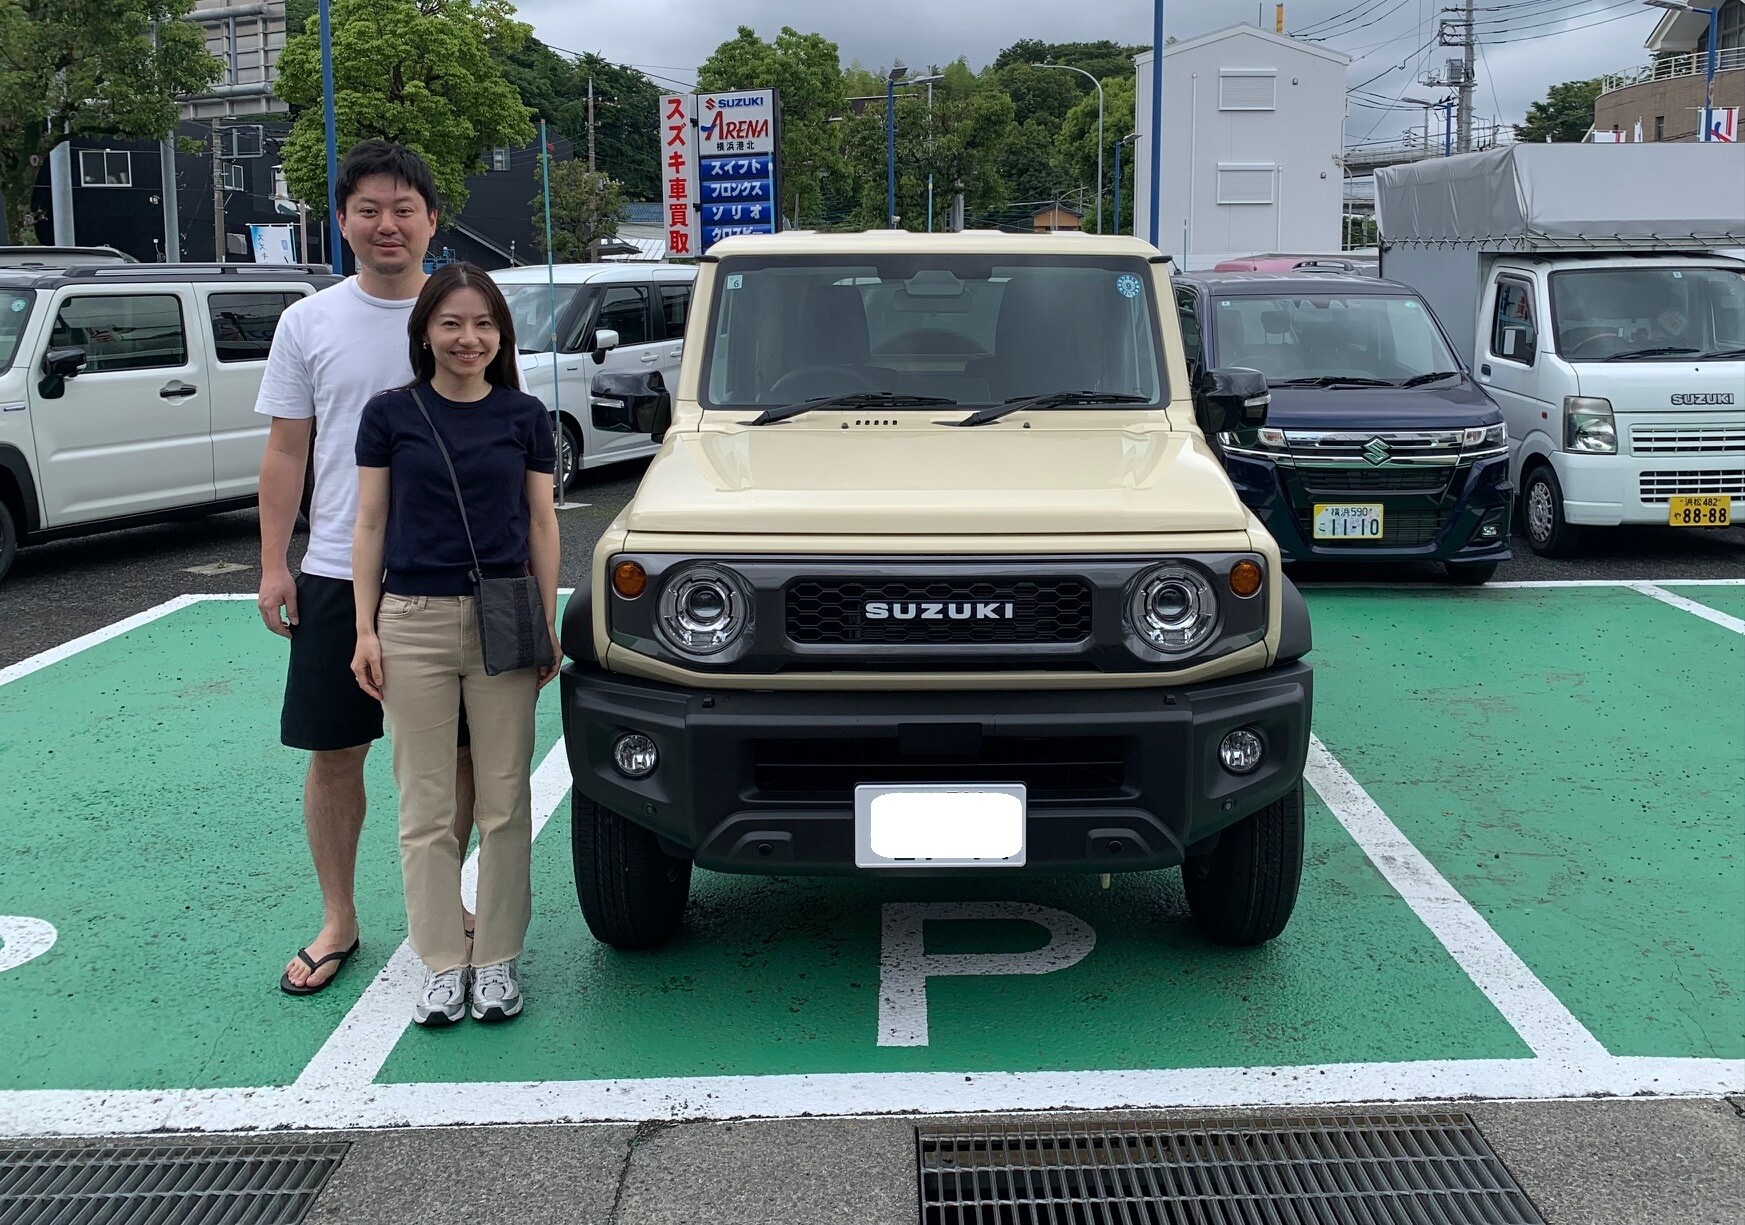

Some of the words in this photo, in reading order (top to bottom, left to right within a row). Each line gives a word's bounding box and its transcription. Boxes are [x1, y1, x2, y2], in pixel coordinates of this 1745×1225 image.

[718, 96, 764, 108] SUZUKI
[700, 110, 769, 141] ARENA
[716, 141, 755, 152] 横浜港北
[711, 159, 762, 176] スイフト
[666, 98, 689, 254] スズキ車買取
[710, 181, 763, 198] フロンクス
[712, 205, 763, 221] ソリオ
[734, 280, 740, 288] 6
[1670, 393, 1735, 405] SUZUKI
[1683, 507, 1727, 523] 88-88
[1318, 522, 1326, 532] こ
[1332, 518, 1379, 536] 11-10
[865, 603, 1014, 619] SUZUKI
[877, 901, 1097, 1047] P
